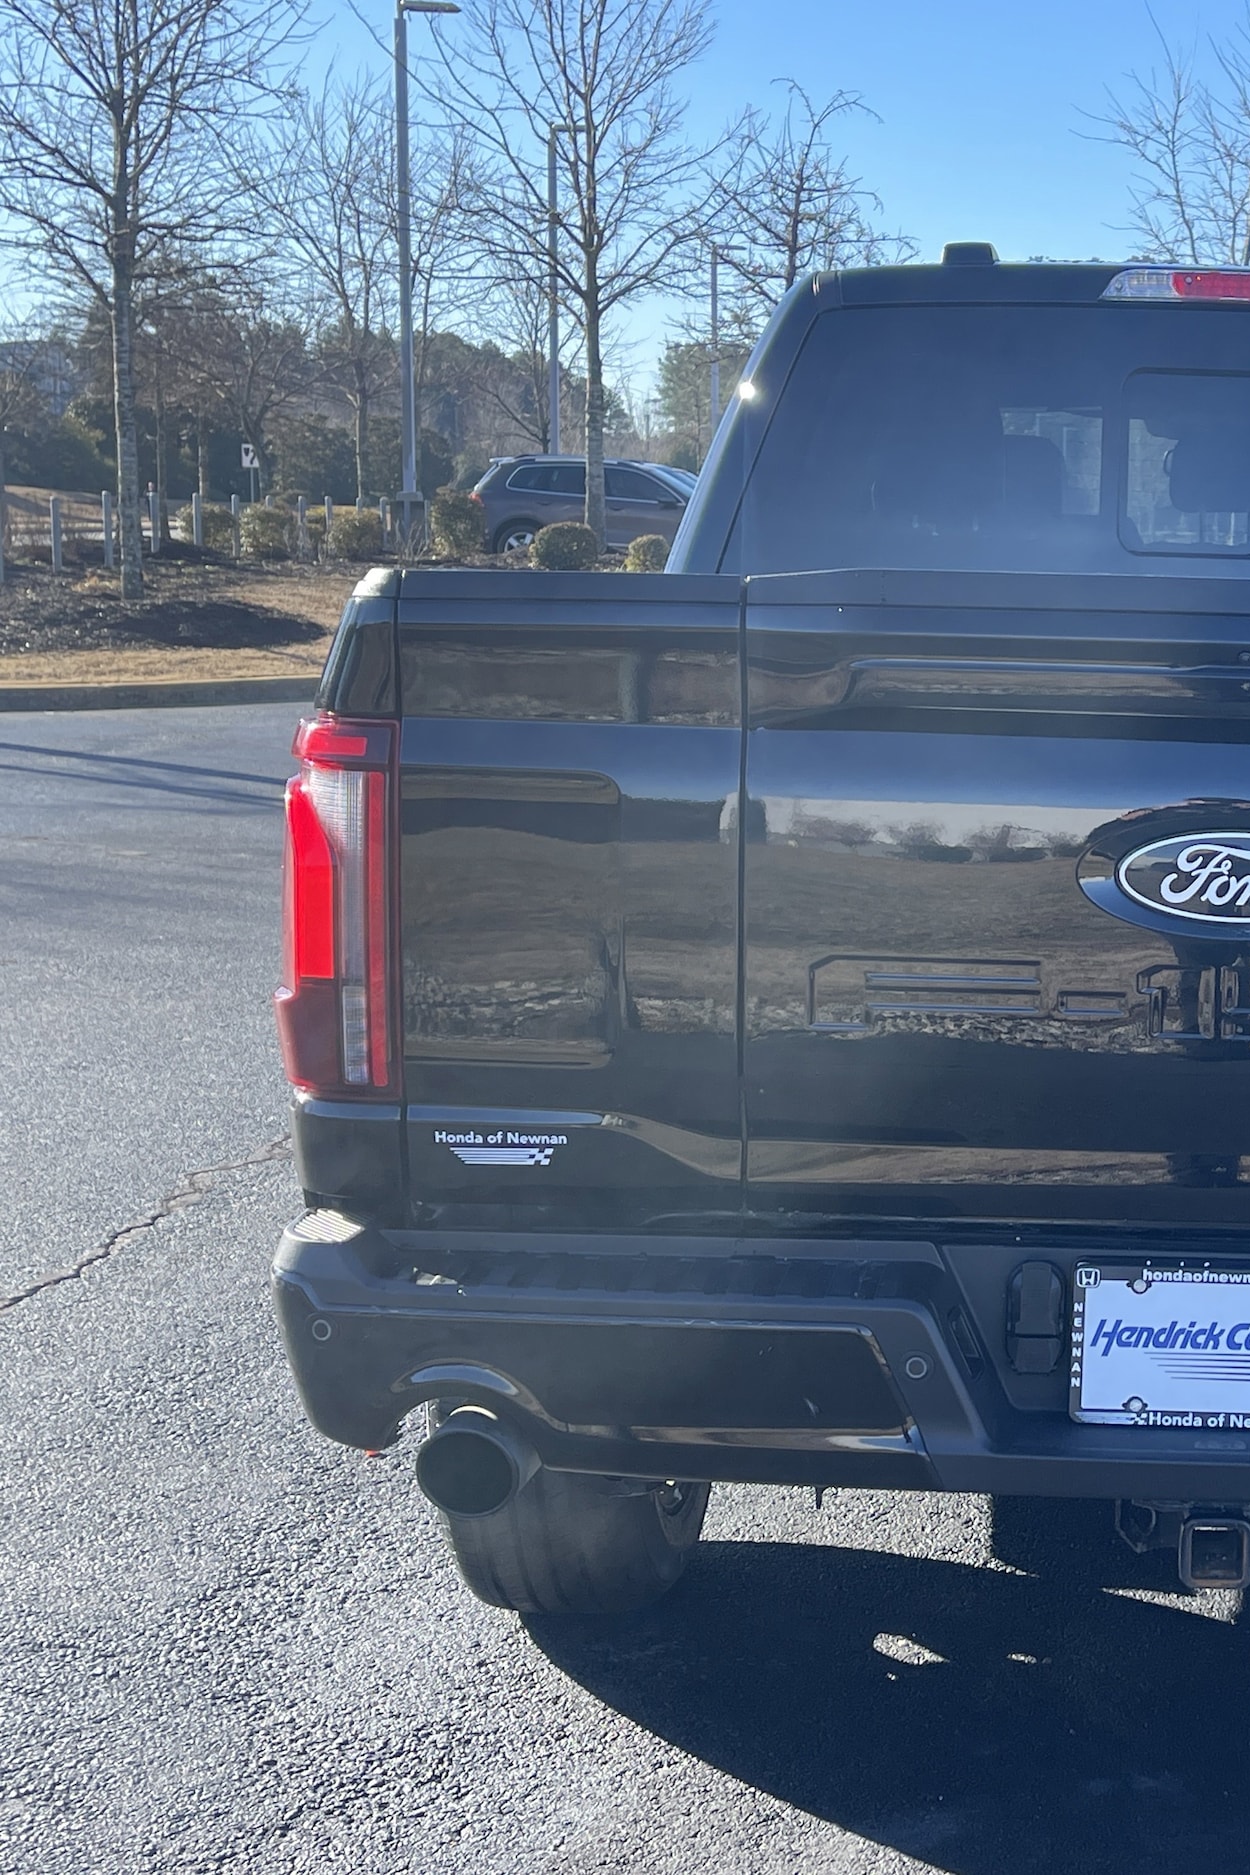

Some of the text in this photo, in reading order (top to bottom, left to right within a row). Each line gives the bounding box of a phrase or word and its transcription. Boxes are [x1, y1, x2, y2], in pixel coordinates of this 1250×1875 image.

[434, 1131, 568, 1145] Honda of Newnan
[1070, 1302, 1084, 1388] NEWNAN
[1149, 1411, 1203, 1427] Honda
[1207, 1413, 1226, 1428] of
